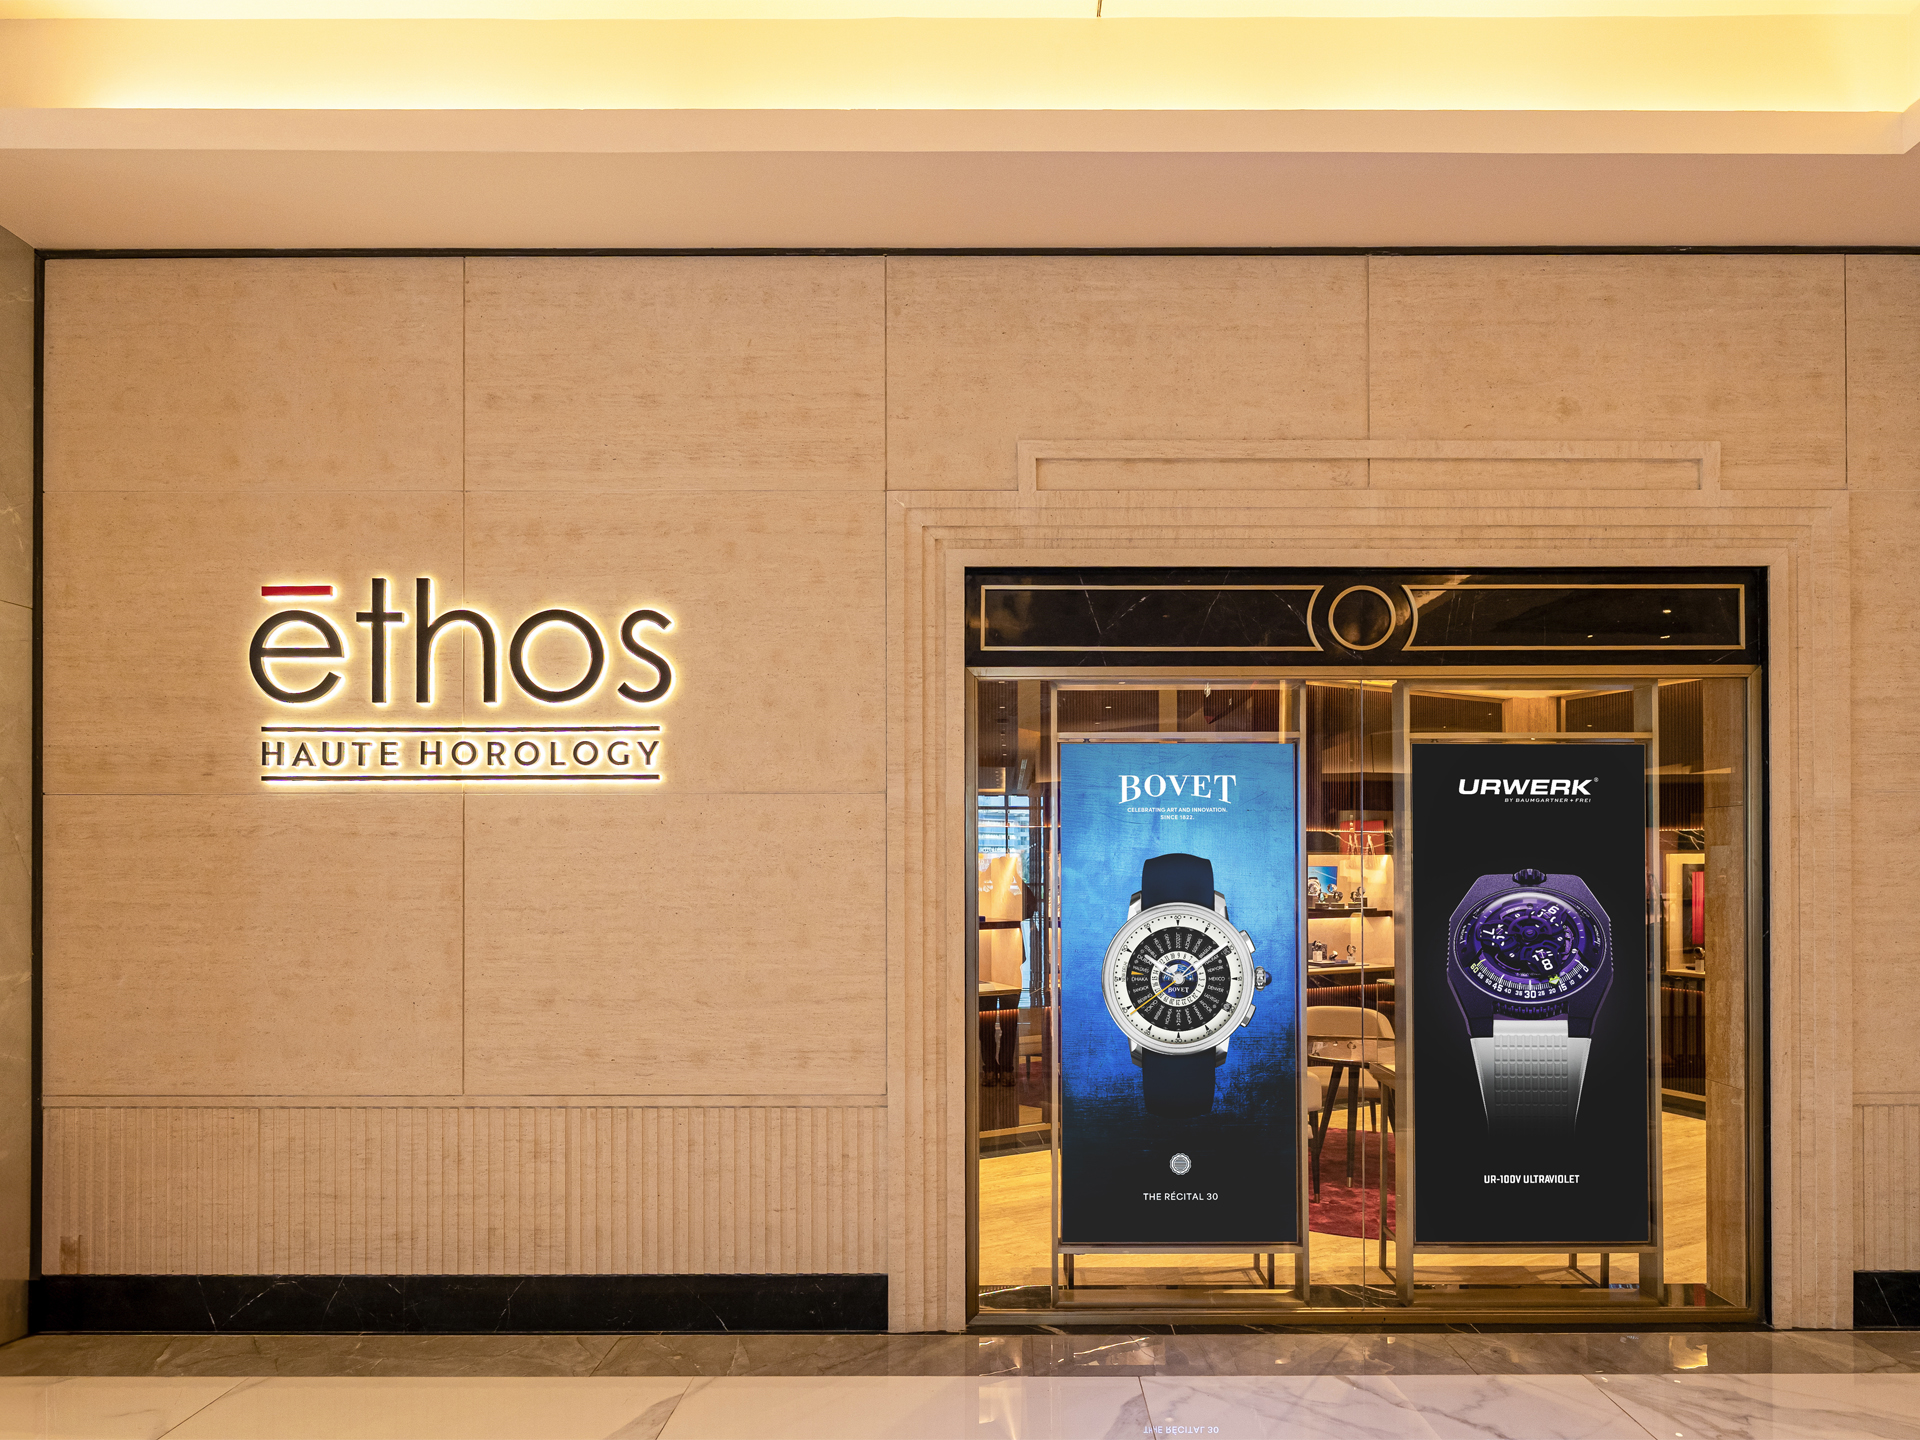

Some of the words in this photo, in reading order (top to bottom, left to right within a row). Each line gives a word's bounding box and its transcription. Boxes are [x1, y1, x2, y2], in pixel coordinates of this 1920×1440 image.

[261, 741, 399, 767] HAUTE
[420, 740, 660, 766] HOROLOGY
[1118, 774, 1237, 804] BOVET
[1470, 963, 1479, 973] 60
[1542, 959, 1553, 970] 8
[1167, 986, 1190, 994] BOVET
[1492, 982, 1503, 992] 45
[1559, 983, 1567, 992] 15
[1524, 990, 1536, 998] 30
[1483, 1175, 1521, 1184] UR-100V
[1523, 1175, 1580, 1184] ULTRAVIOLET
[1143, 1193, 1161, 1201] THE
[1164, 1191, 1204, 1201] RÉCITAL
[1206, 1193, 1219, 1201] 30
